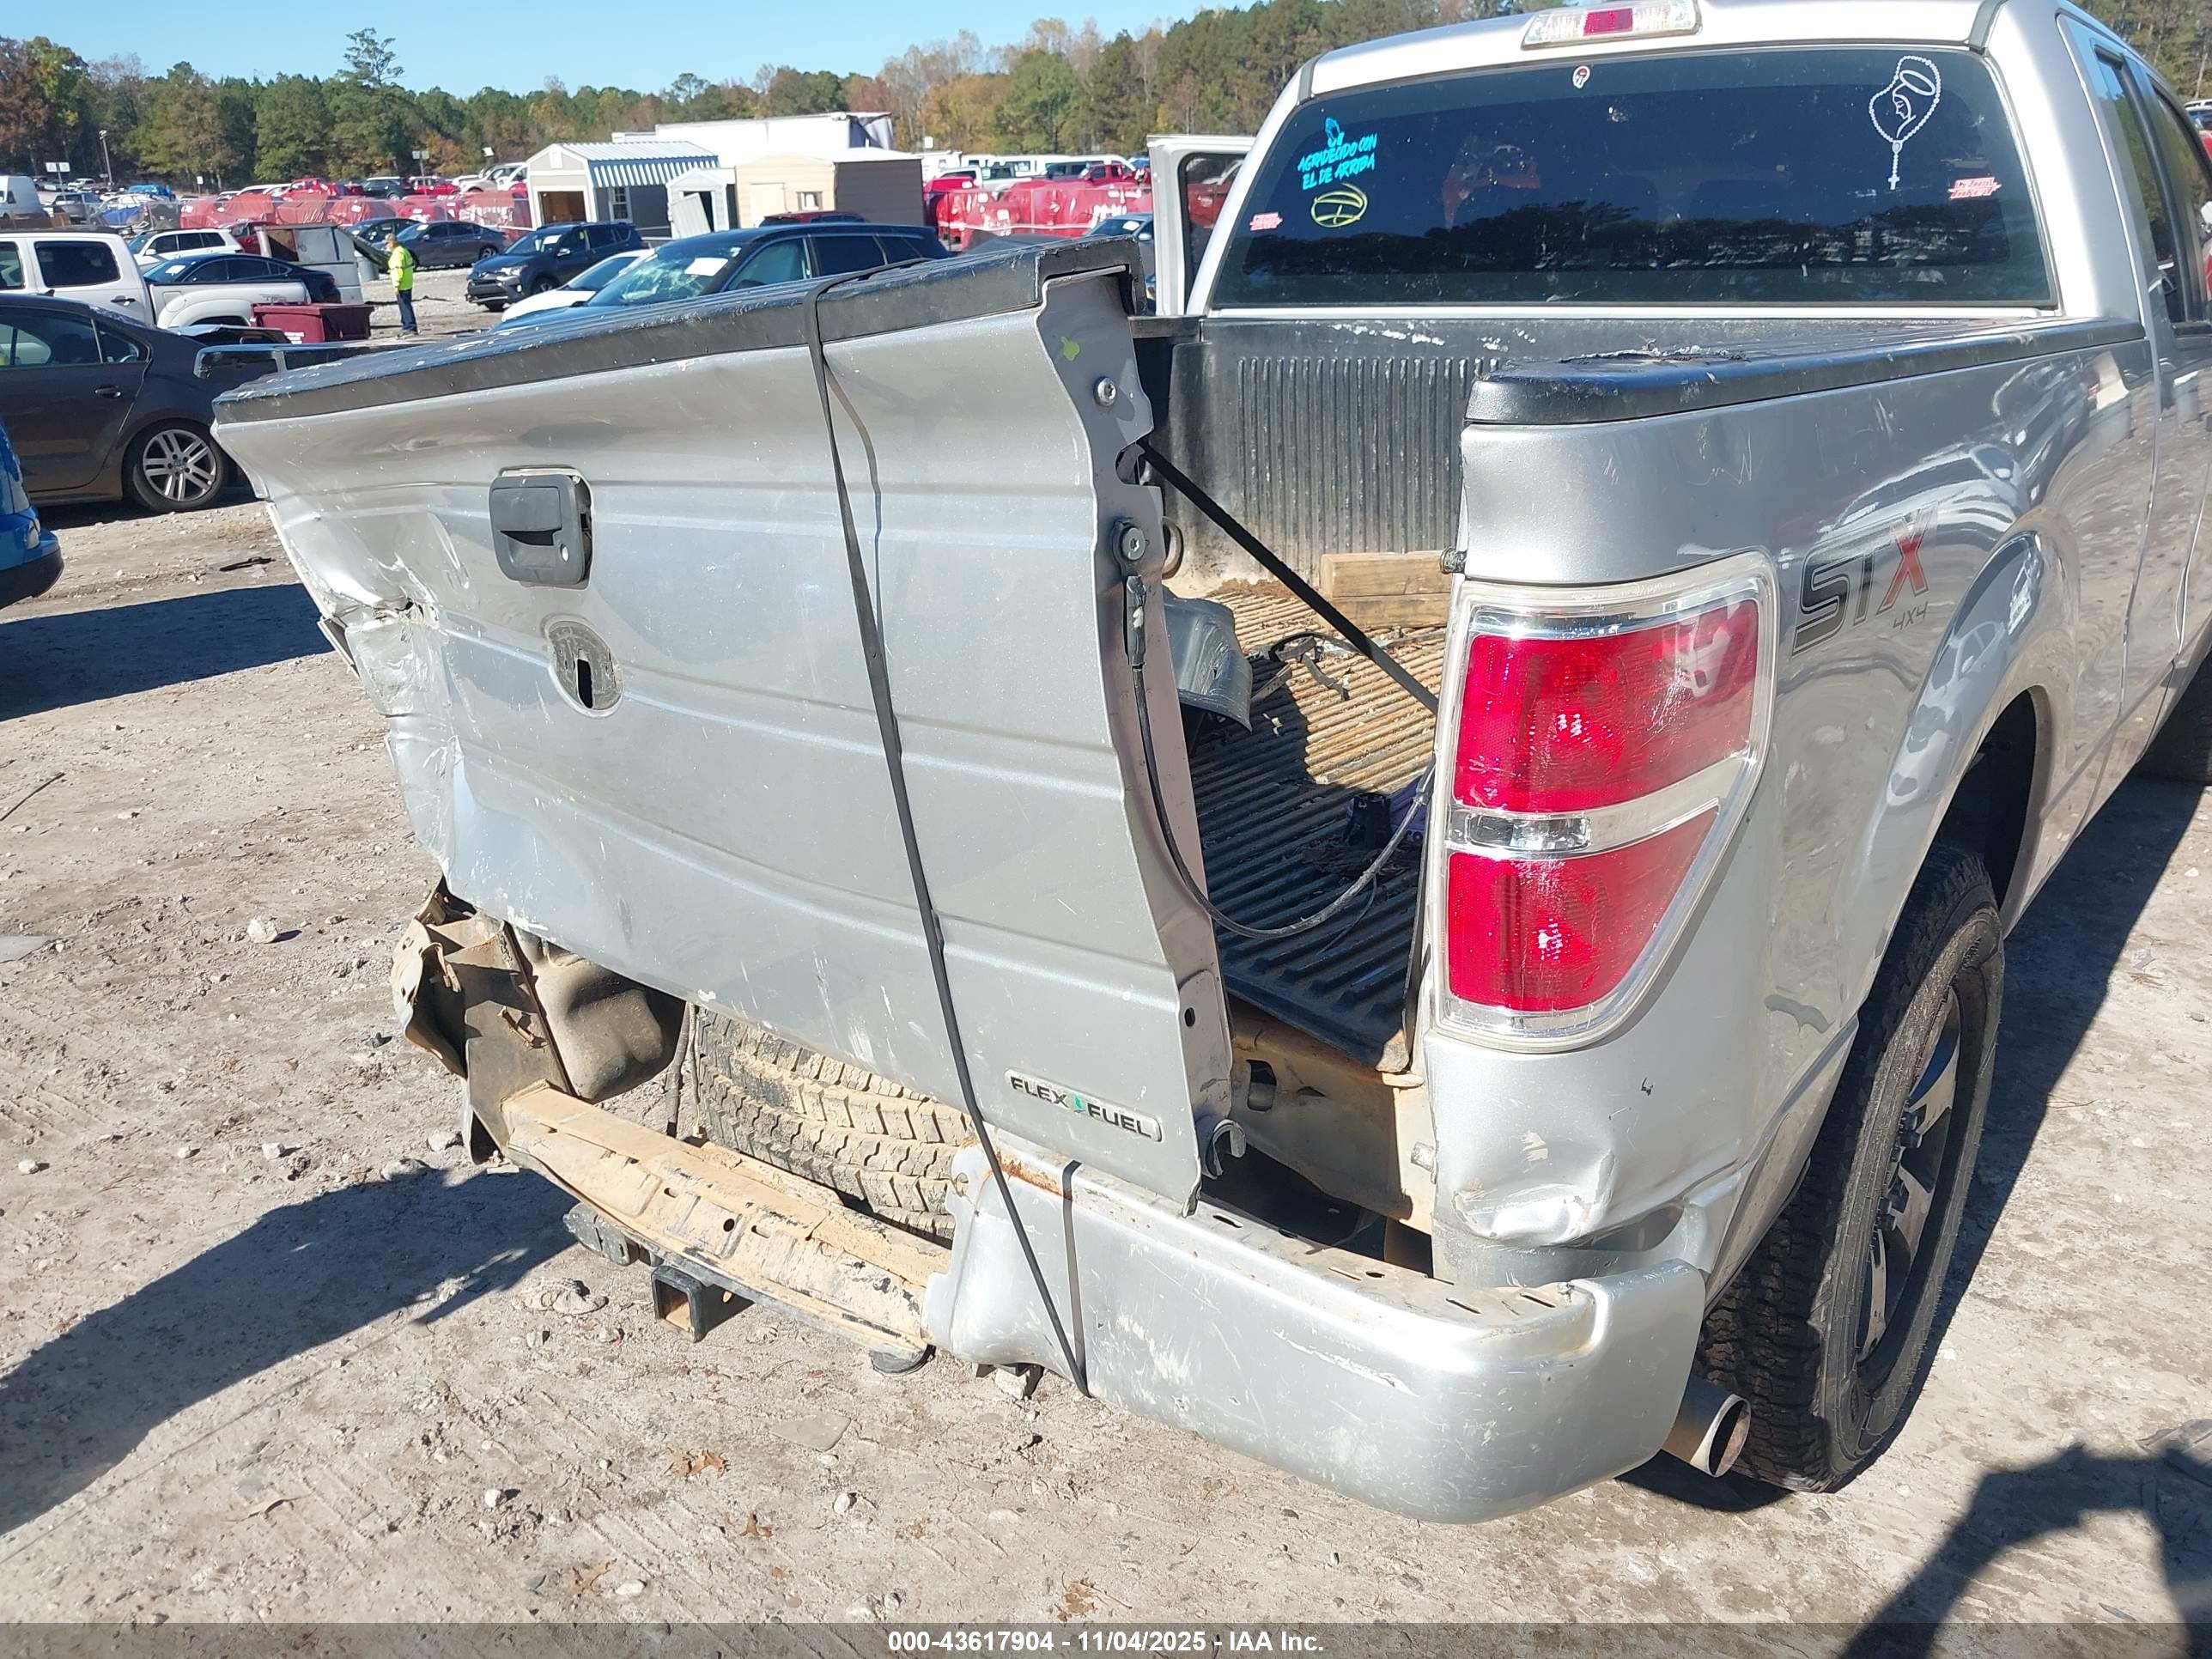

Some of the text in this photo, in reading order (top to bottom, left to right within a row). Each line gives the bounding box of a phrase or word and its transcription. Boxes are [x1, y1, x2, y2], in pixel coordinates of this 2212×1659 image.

[1358, 131, 1377, 153] CON
[1303, 152, 1376, 190] EL DE ARRIBA
[1791, 502, 1937, 656] STX
[1011, 1076, 1152, 1139] FLEX FUEL
